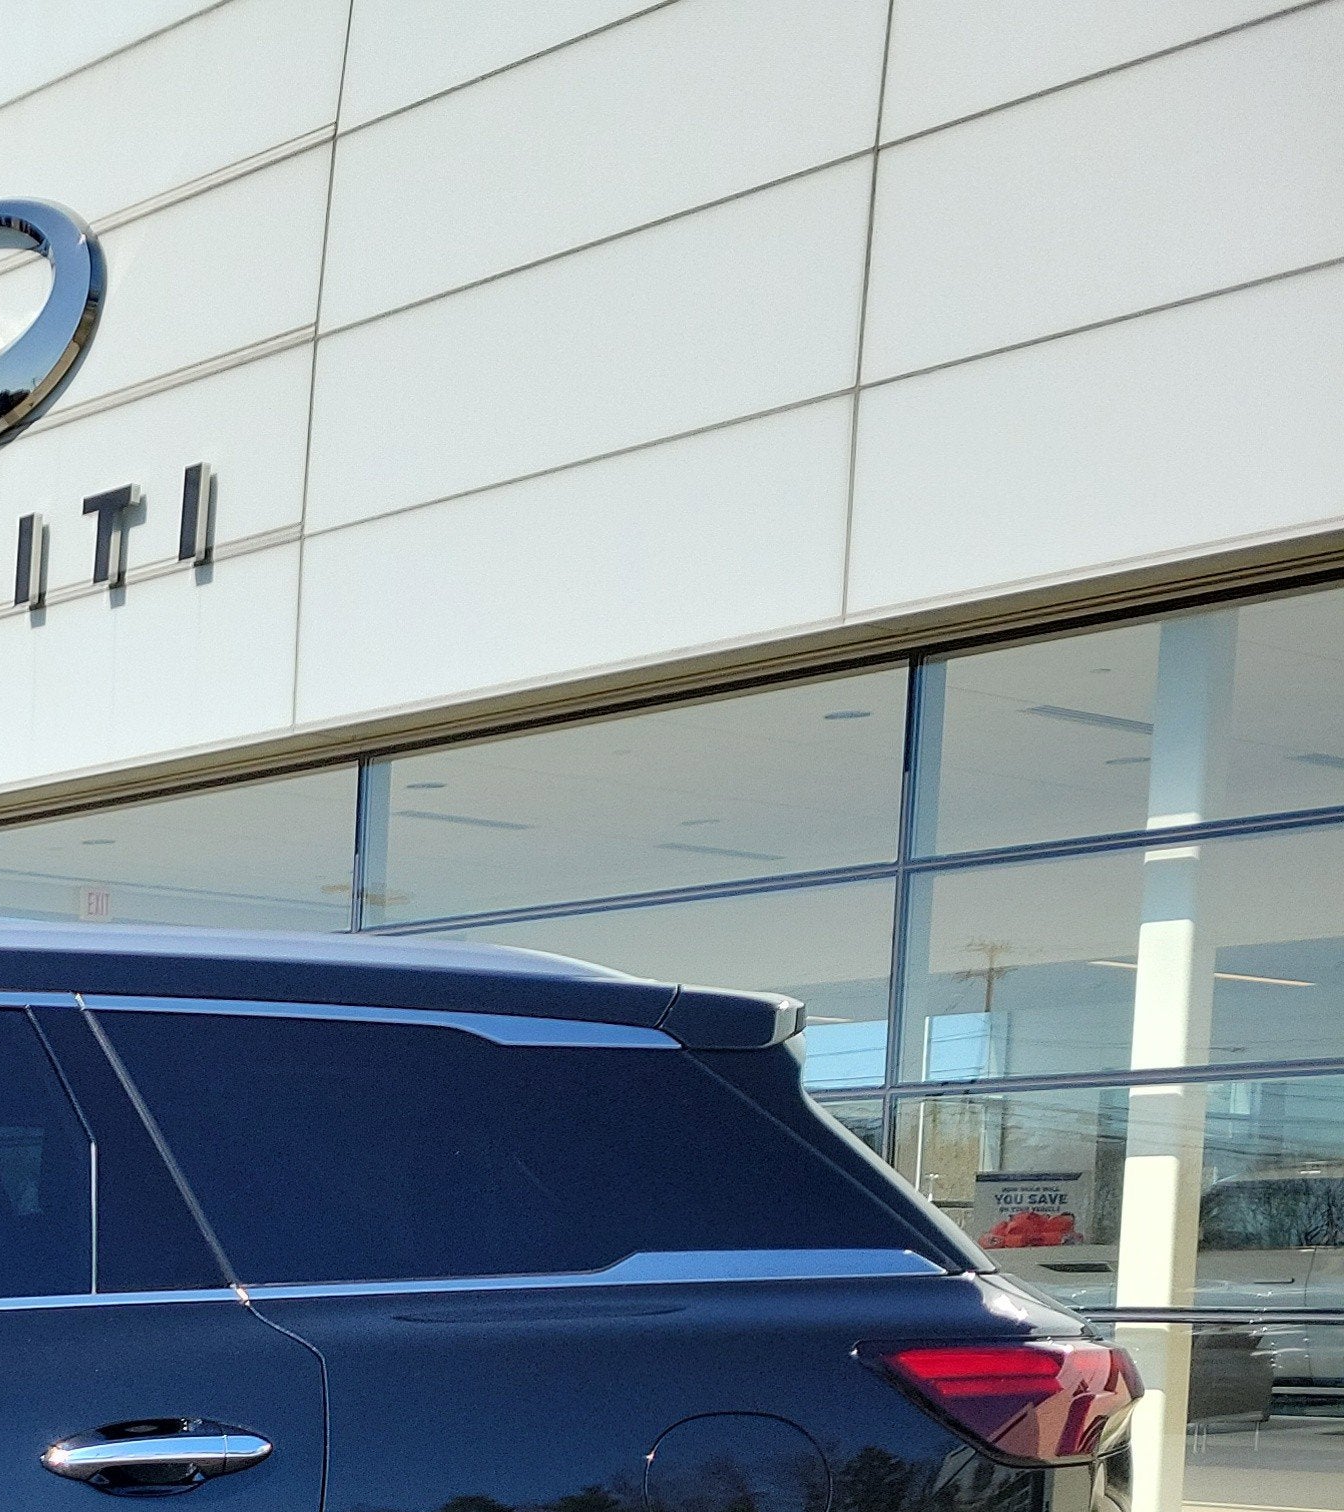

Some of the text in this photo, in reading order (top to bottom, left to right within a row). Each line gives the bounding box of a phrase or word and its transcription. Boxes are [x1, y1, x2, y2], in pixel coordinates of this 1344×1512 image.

[87, 892, 110, 916] EXIT
[994, 1194, 1068, 1205] YOU SAVE
